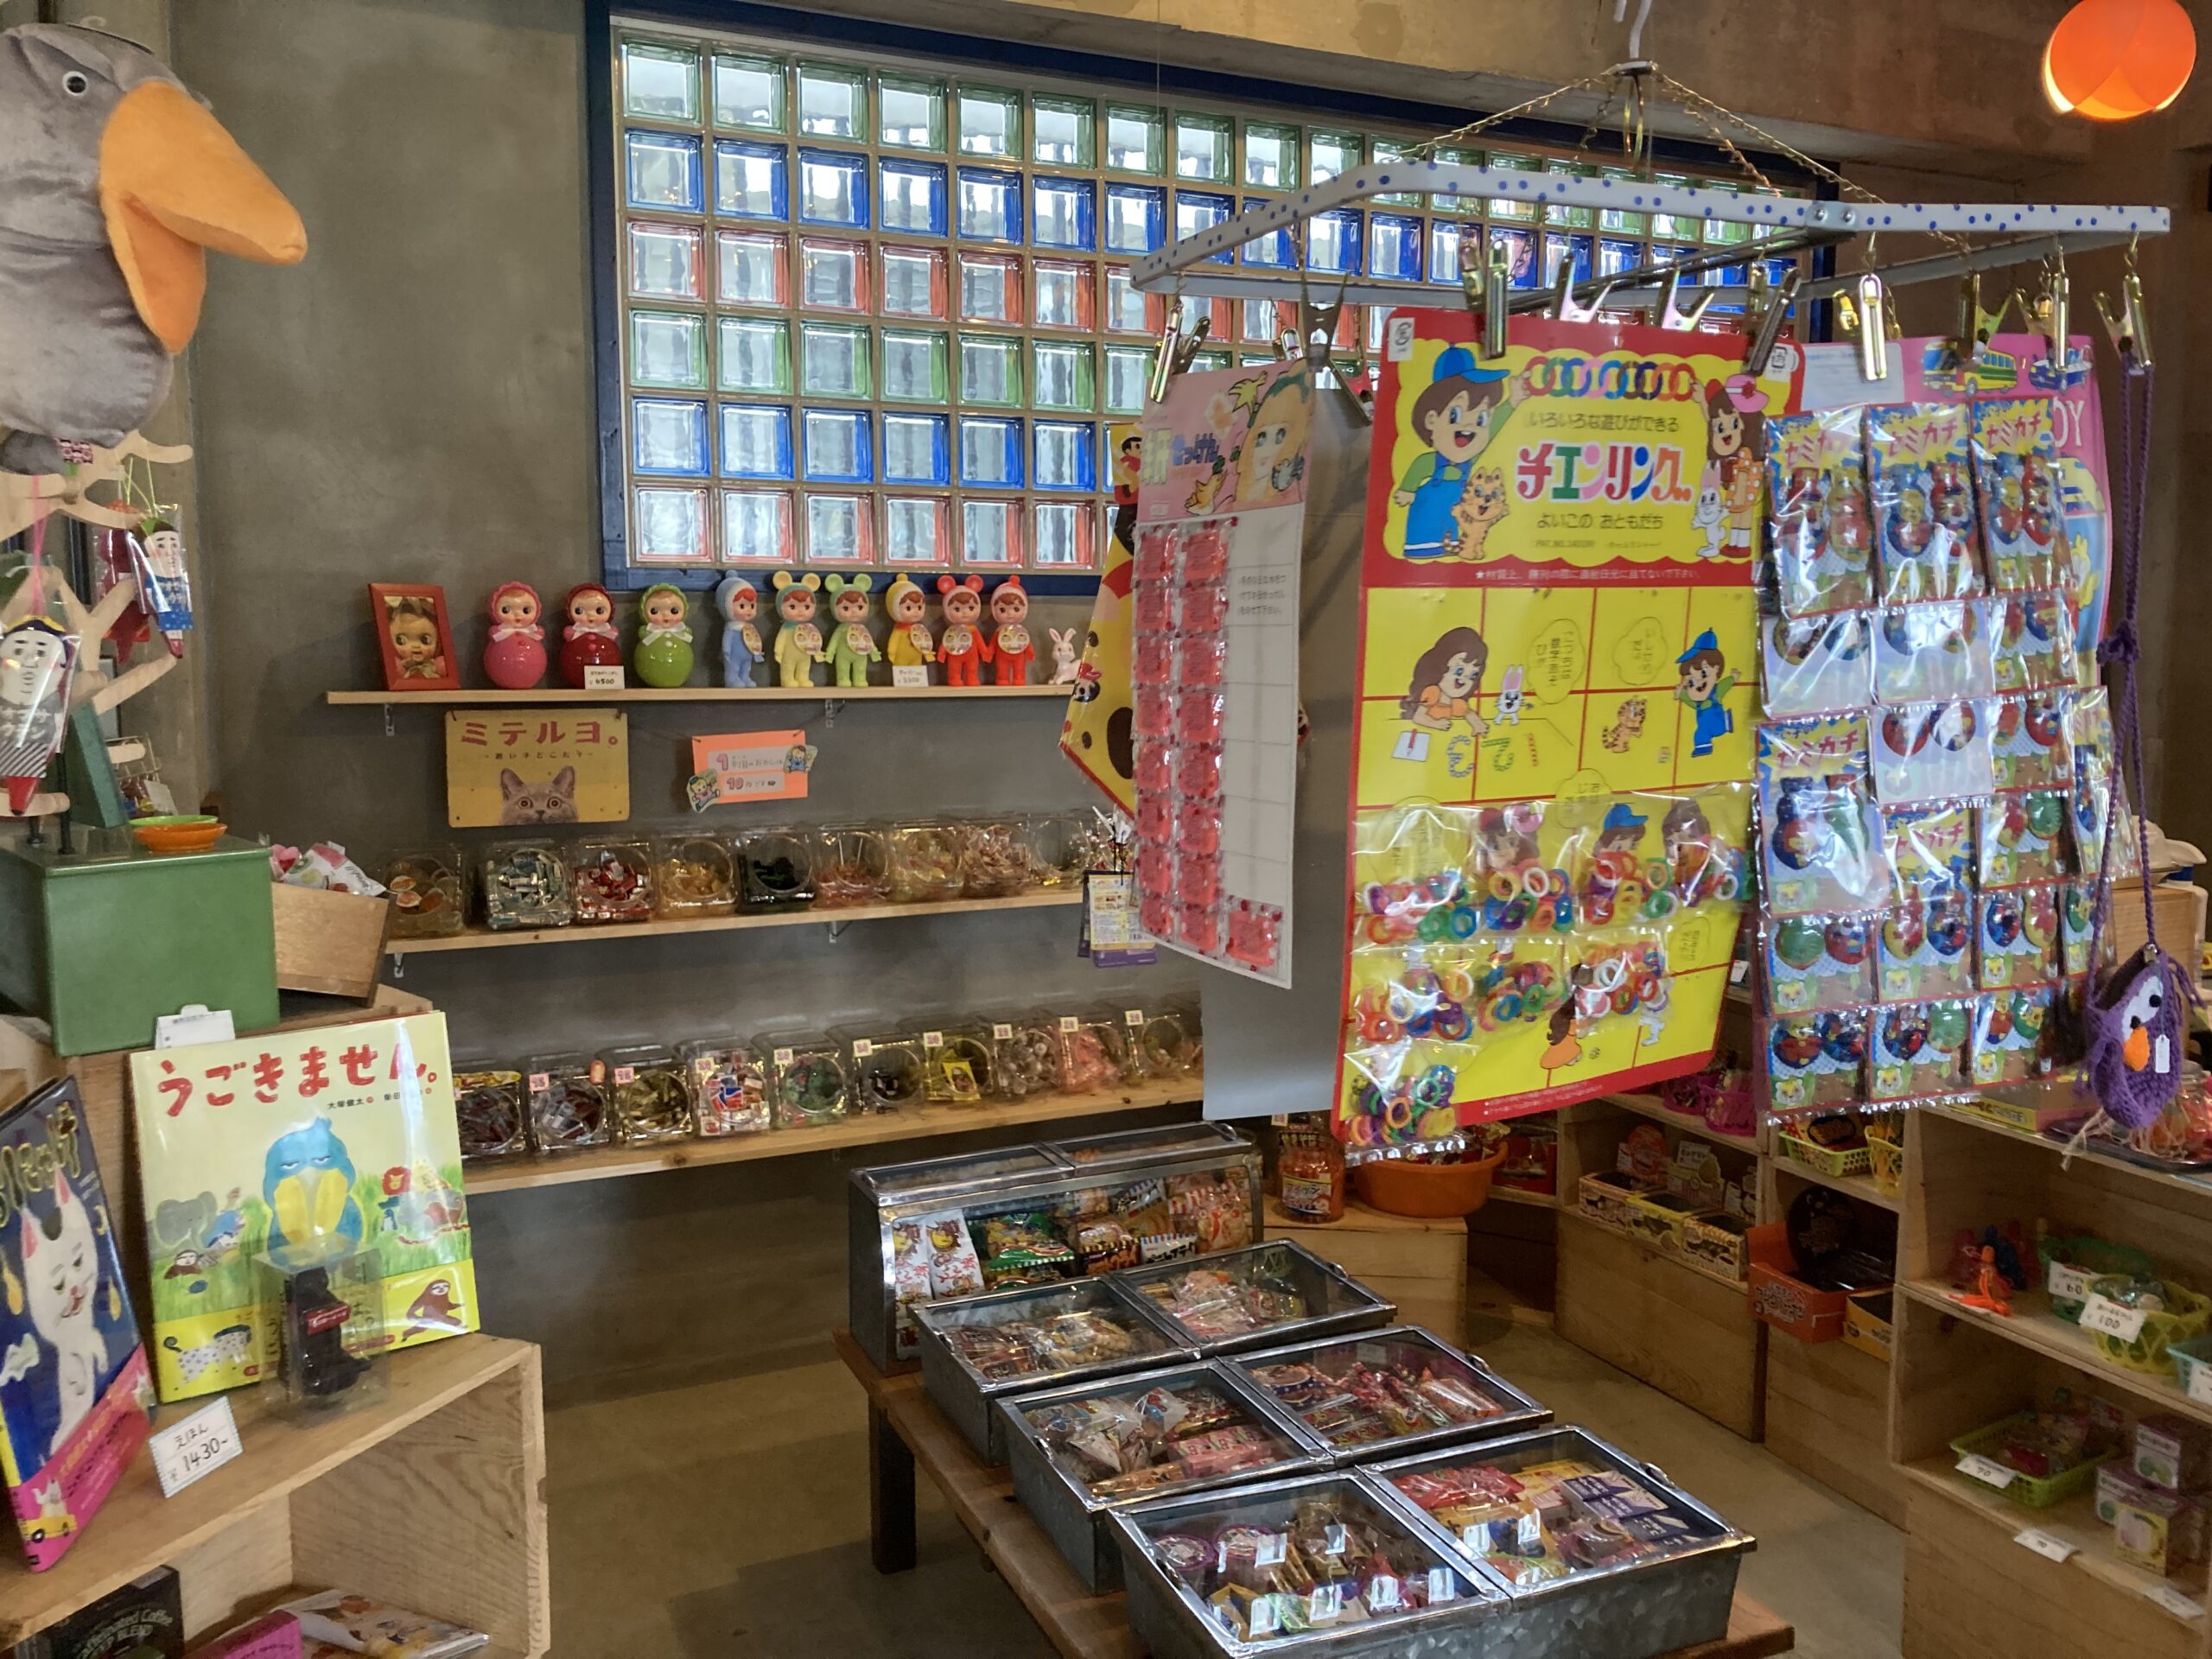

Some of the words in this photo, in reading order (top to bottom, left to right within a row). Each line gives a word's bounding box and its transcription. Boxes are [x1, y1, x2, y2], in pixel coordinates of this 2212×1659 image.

[1529, 411, 1680, 433] いろいろな遊びができる
[1987, 411, 2041, 449] セミカチ
[1537, 513, 1593, 529] よいこの
[1600, 513, 1663, 530] おともだち
[461, 721, 619, 747] ミテルヨ。
[159, 1044, 438, 1116] うごきません。
[175, 1423, 209, 1450] えほん
